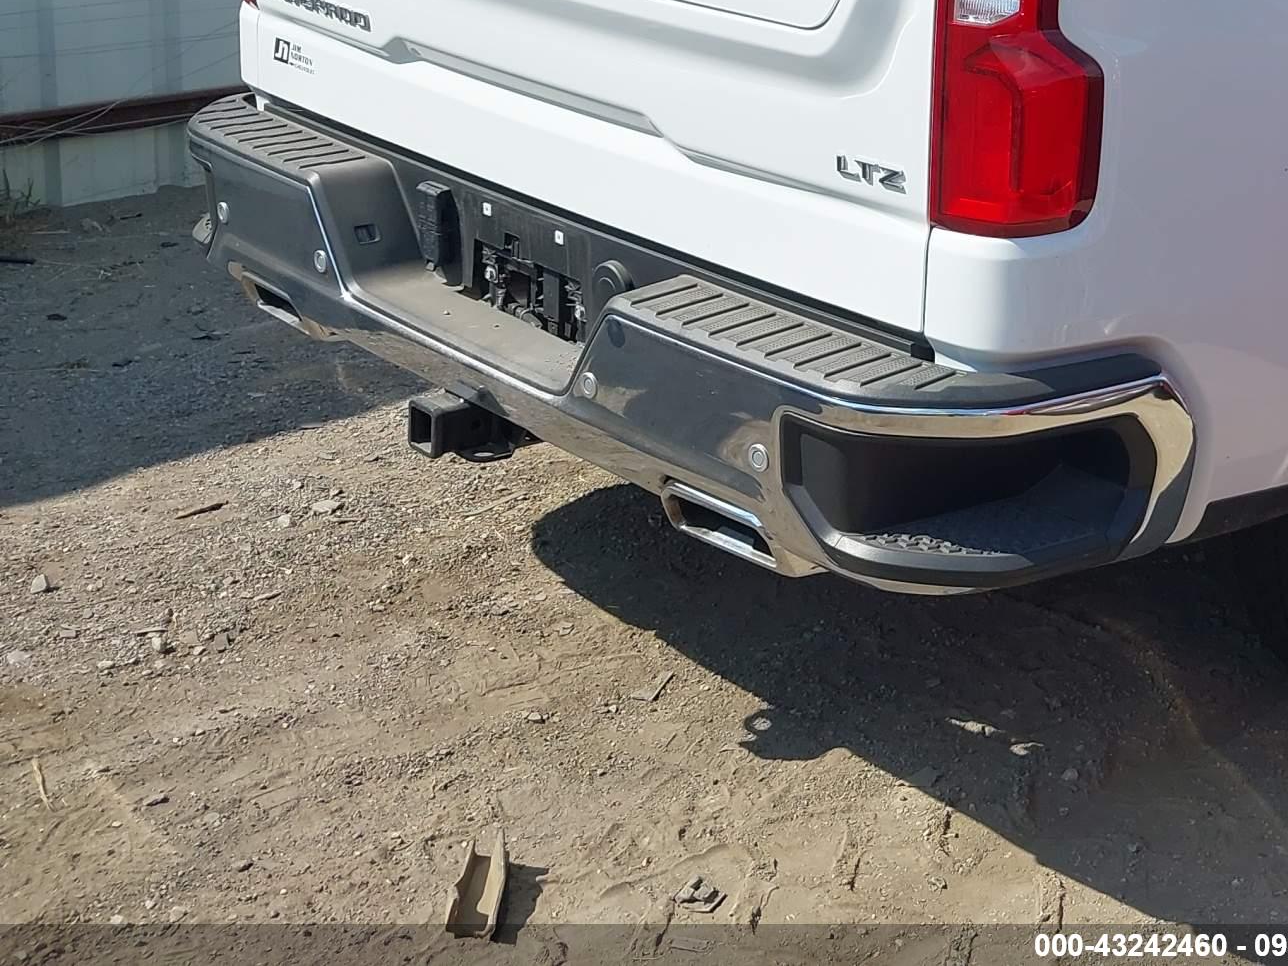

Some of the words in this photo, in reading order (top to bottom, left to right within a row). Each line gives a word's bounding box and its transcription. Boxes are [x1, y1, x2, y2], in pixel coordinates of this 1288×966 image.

[291, 44, 302, 53] JIM
[291, 51, 313, 66] NORTON
[836, 155, 907, 194] LTZ
